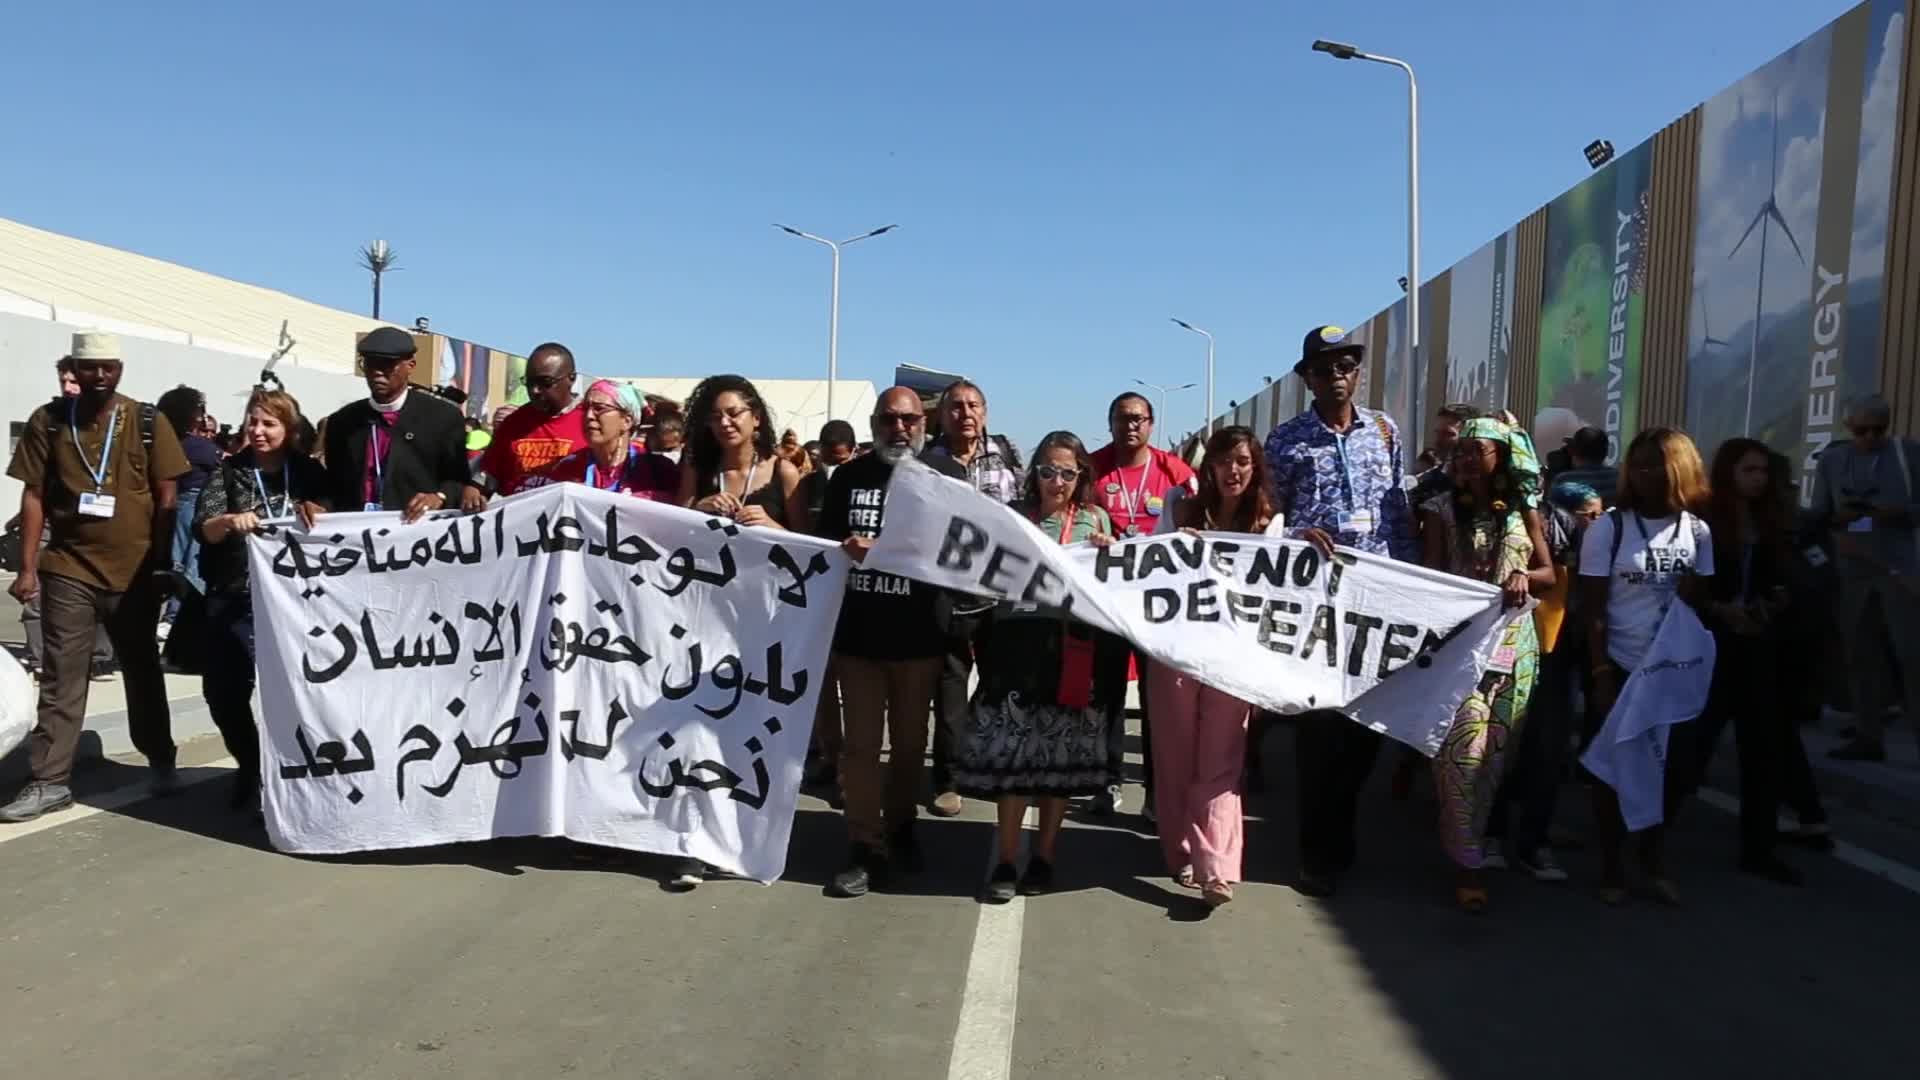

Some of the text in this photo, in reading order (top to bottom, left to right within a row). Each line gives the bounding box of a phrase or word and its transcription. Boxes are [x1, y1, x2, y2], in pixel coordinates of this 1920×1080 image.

[1604, 209, 1632, 467] ODIVERSITY
[1800, 265, 1843, 509] ENERGY
[516, 441, 571, 457] SYSTEM
[848, 509, 879, 527] FREE
[850, 489, 881, 506] FREE
[767, 543, 830, 608] لا
[849, 573, 911, 595] REE ALAA
[1095, 537, 1357, 597] HAVE NOT
[1645, 557, 1692, 572] REA
[280, 724, 375, 805] بعد
